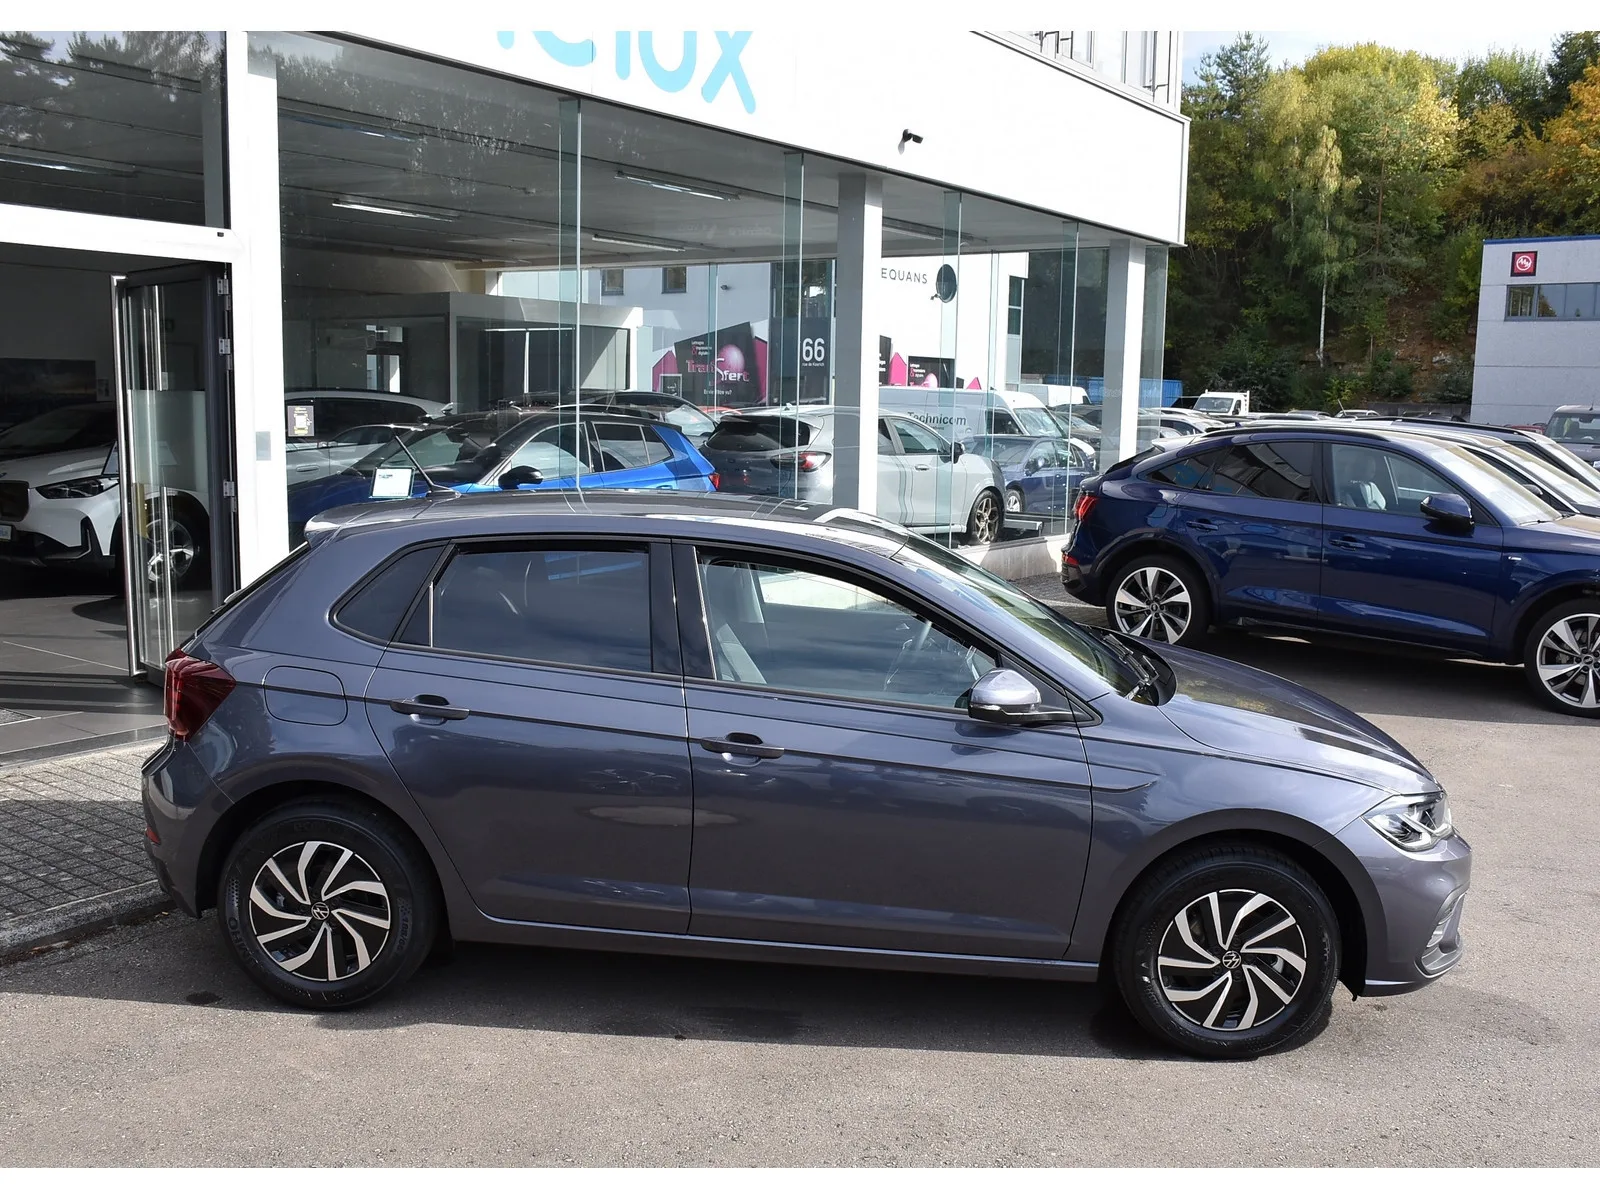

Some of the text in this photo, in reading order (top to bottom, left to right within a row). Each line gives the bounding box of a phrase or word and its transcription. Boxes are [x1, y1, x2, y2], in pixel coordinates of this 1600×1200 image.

[881, 267, 928, 285] EQUANS
[802, 337, 825, 361] 66
[907, 411, 967, 426] Technicom
